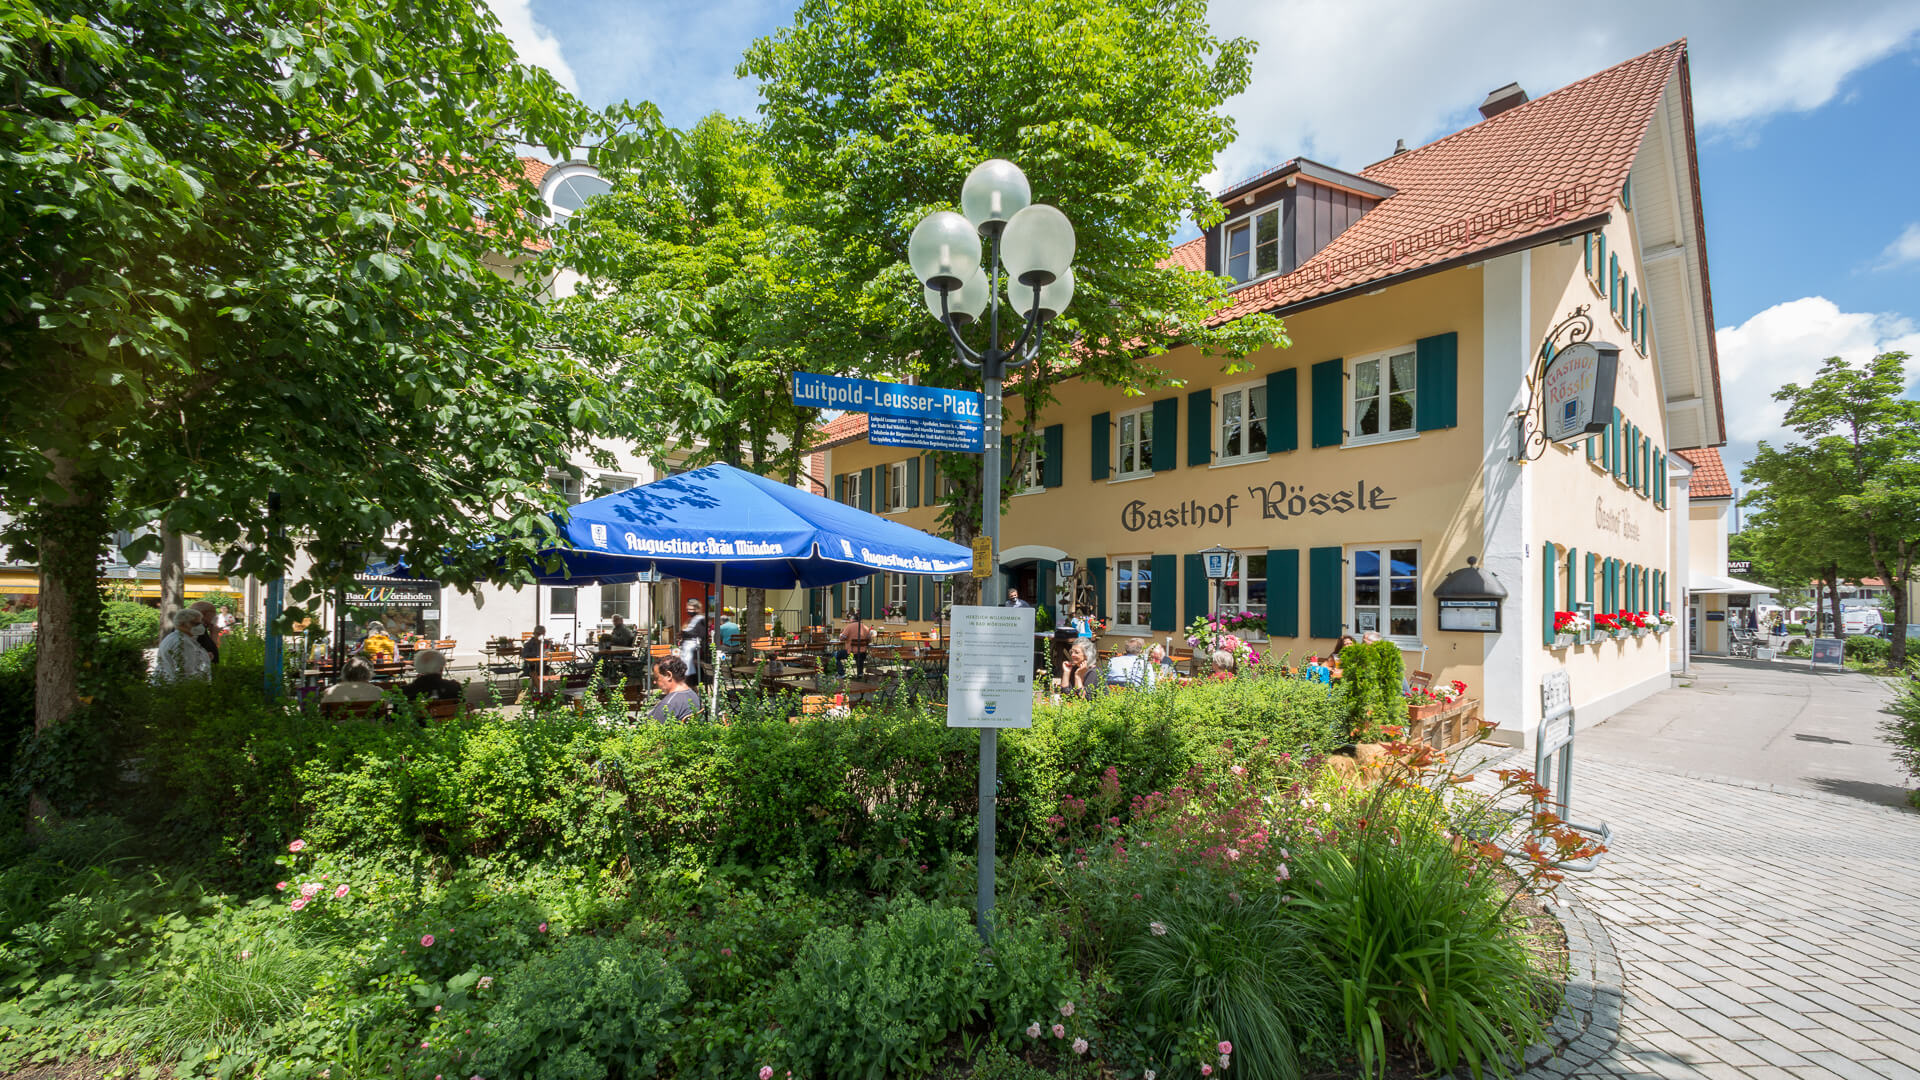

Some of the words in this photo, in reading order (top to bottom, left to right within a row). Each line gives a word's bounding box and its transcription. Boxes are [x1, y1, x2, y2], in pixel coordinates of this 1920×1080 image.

[795, 377, 980, 416] Luitpold-Leusser-Platz
[1121, 494, 1240, 532] Gasthof
[1247, 480, 1398, 521] Rössle
[734, 540, 784, 556] München
